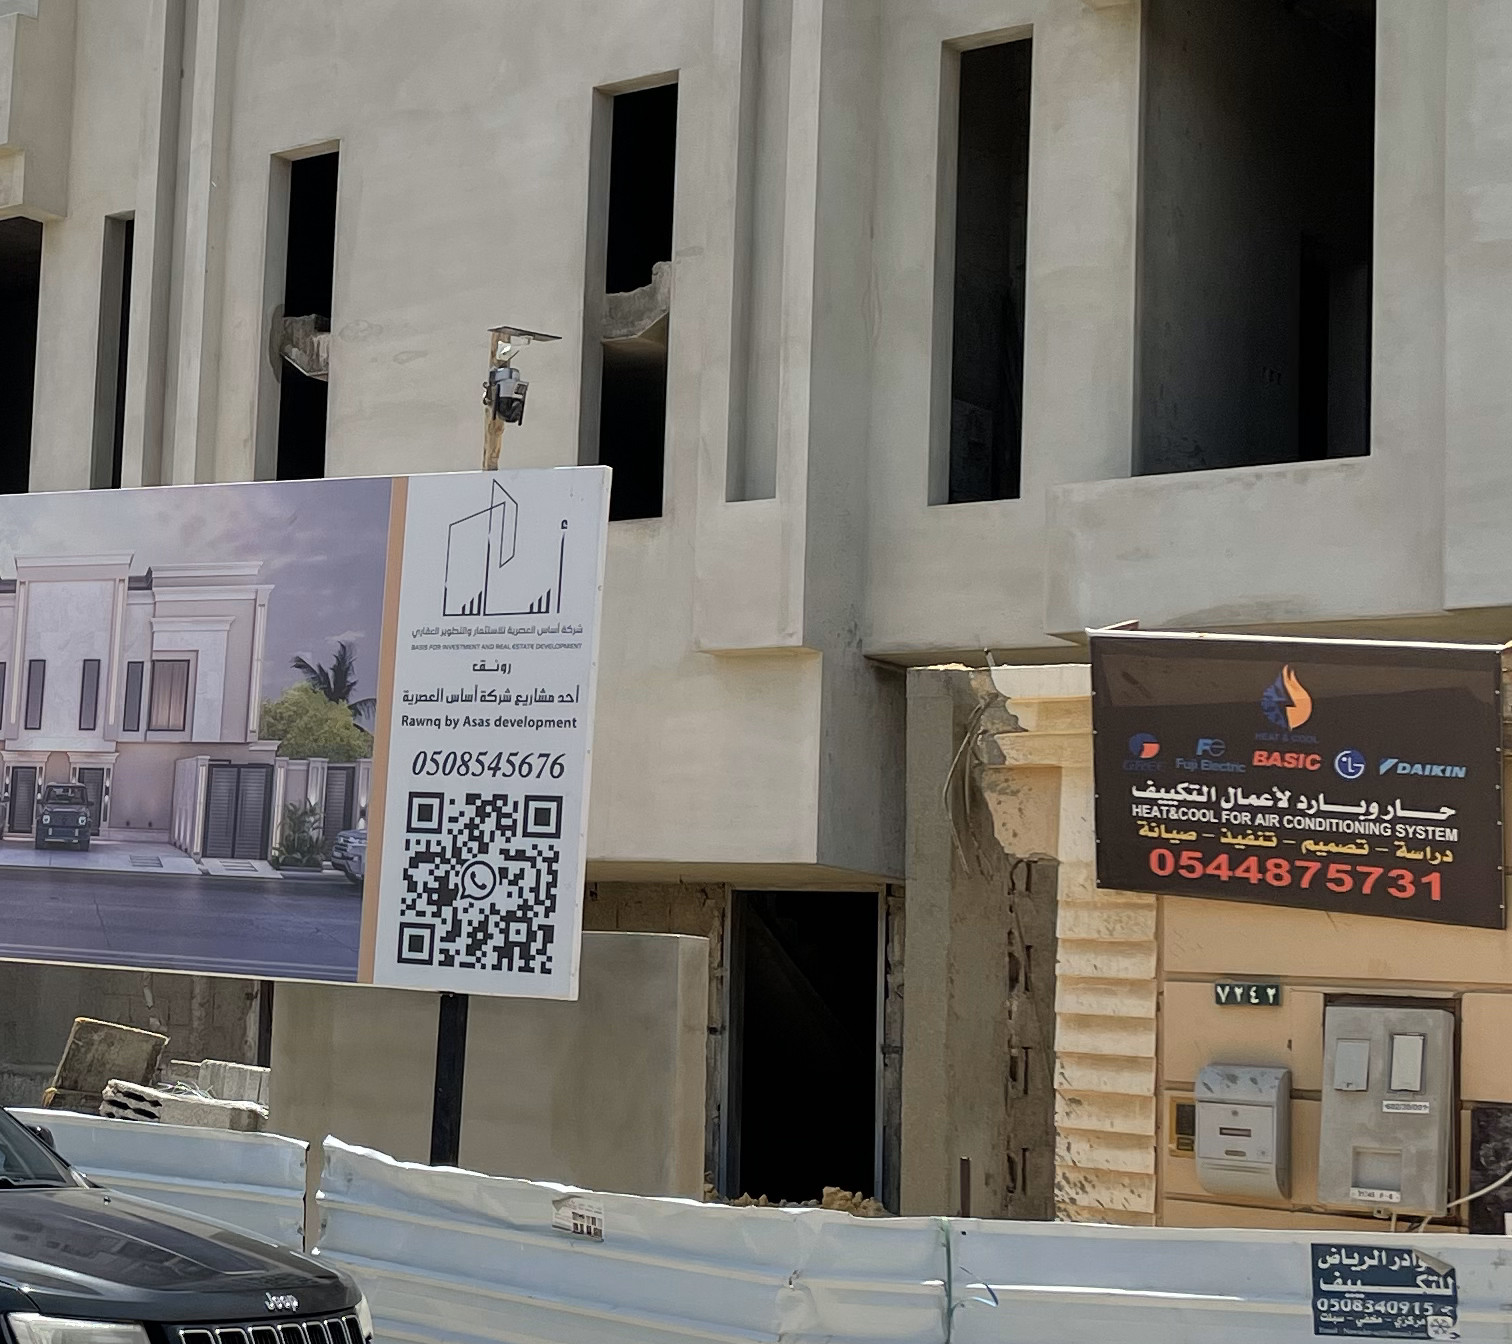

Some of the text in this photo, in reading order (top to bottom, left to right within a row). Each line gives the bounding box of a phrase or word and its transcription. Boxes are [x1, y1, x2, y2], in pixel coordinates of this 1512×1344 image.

[507, 625, 536, 636] العصرية
[537, 622, 560, 637] أساس
[561, 624, 583, 635] شركة
[402, 684, 580, 706] أحد مشاريع شركة أساس العصرية
[401, 715, 577, 731] Rawnq by Asas development
[412, 750, 566, 779] 0508545676
[1201, 760, 1246, 773] Electric
[1252, 750, 1322, 771] BASIC
[1396, 762, 1467, 778] DAIKIN
[1132, 780, 1217, 806] التكييف
[1220, 786, 1291, 809] لأعمال
[1131, 804, 1459, 842] HEAT&COOL FOR AIR CONDITIONING SYSTEM
[1136, 820, 1454, 865] دراسة تصميم تنفيذ صيانة
[1149, 848, 1442, 901] 0544875731
[1317, 1247, 1387, 1270] الرياض
[264, 1292, 299, 1312] Jeep
[1317, 1298, 1434, 1316] 0508340915
